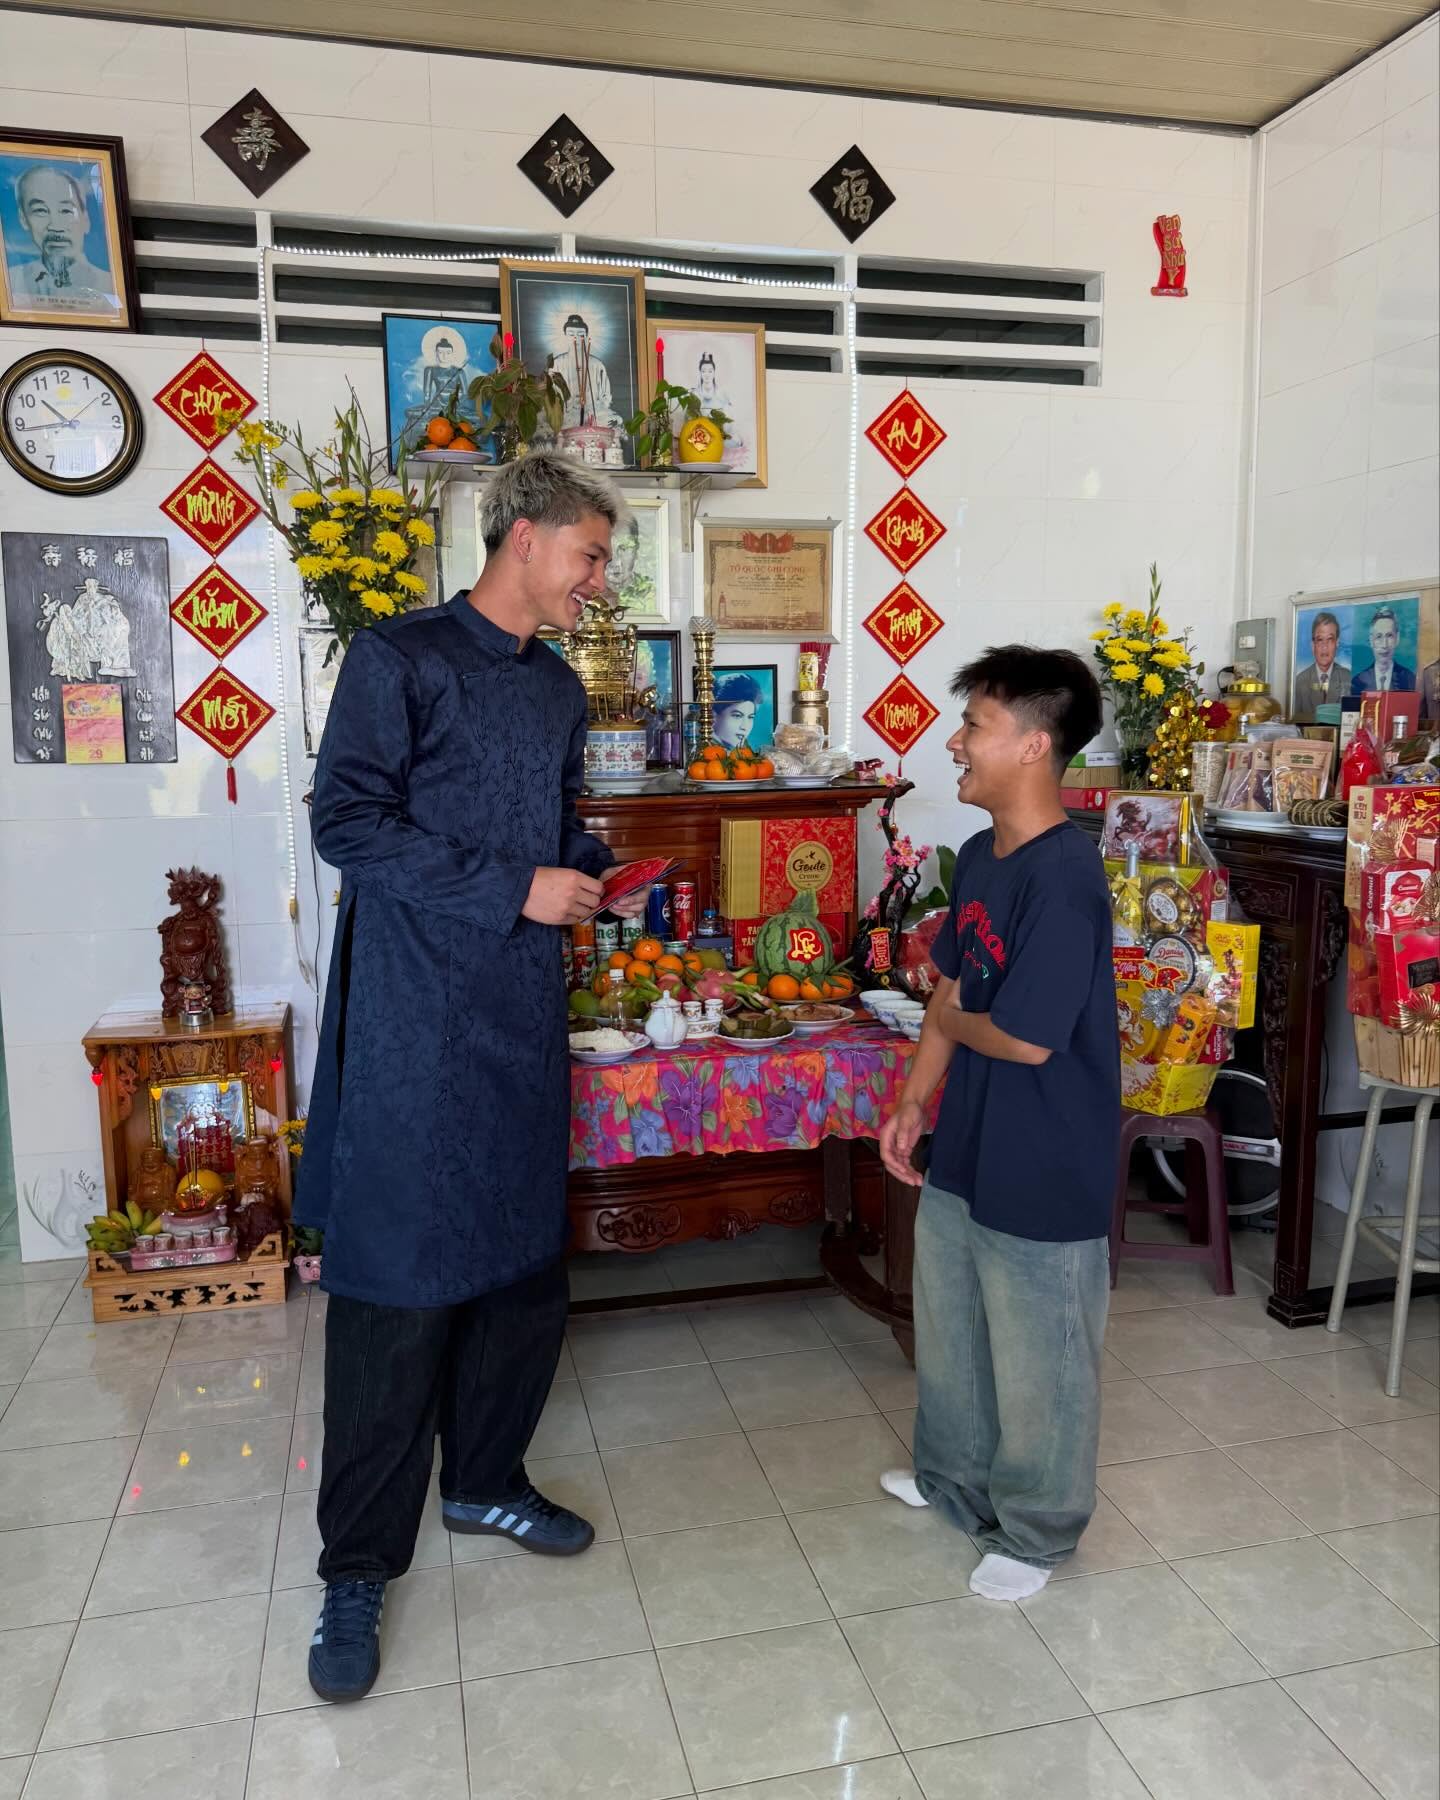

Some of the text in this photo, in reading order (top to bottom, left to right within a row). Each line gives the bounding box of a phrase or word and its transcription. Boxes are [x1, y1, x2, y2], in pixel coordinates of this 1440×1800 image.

[832, 167, 874, 224] 福
[33, 376, 48, 391] 11
[53, 370, 71, 384] 12
[82, 375, 90, 390] 1
[17, 393, 36, 408] 10
[100, 391, 112, 406] 2
[14, 416, 26, 432] 9
[111, 414, 121, 429] 3
[886, 417, 923, 451] AN
[25, 439, 36, 454] 8
[45, 454, 56, 470] 7
[192, 587, 239, 630] NĂM
